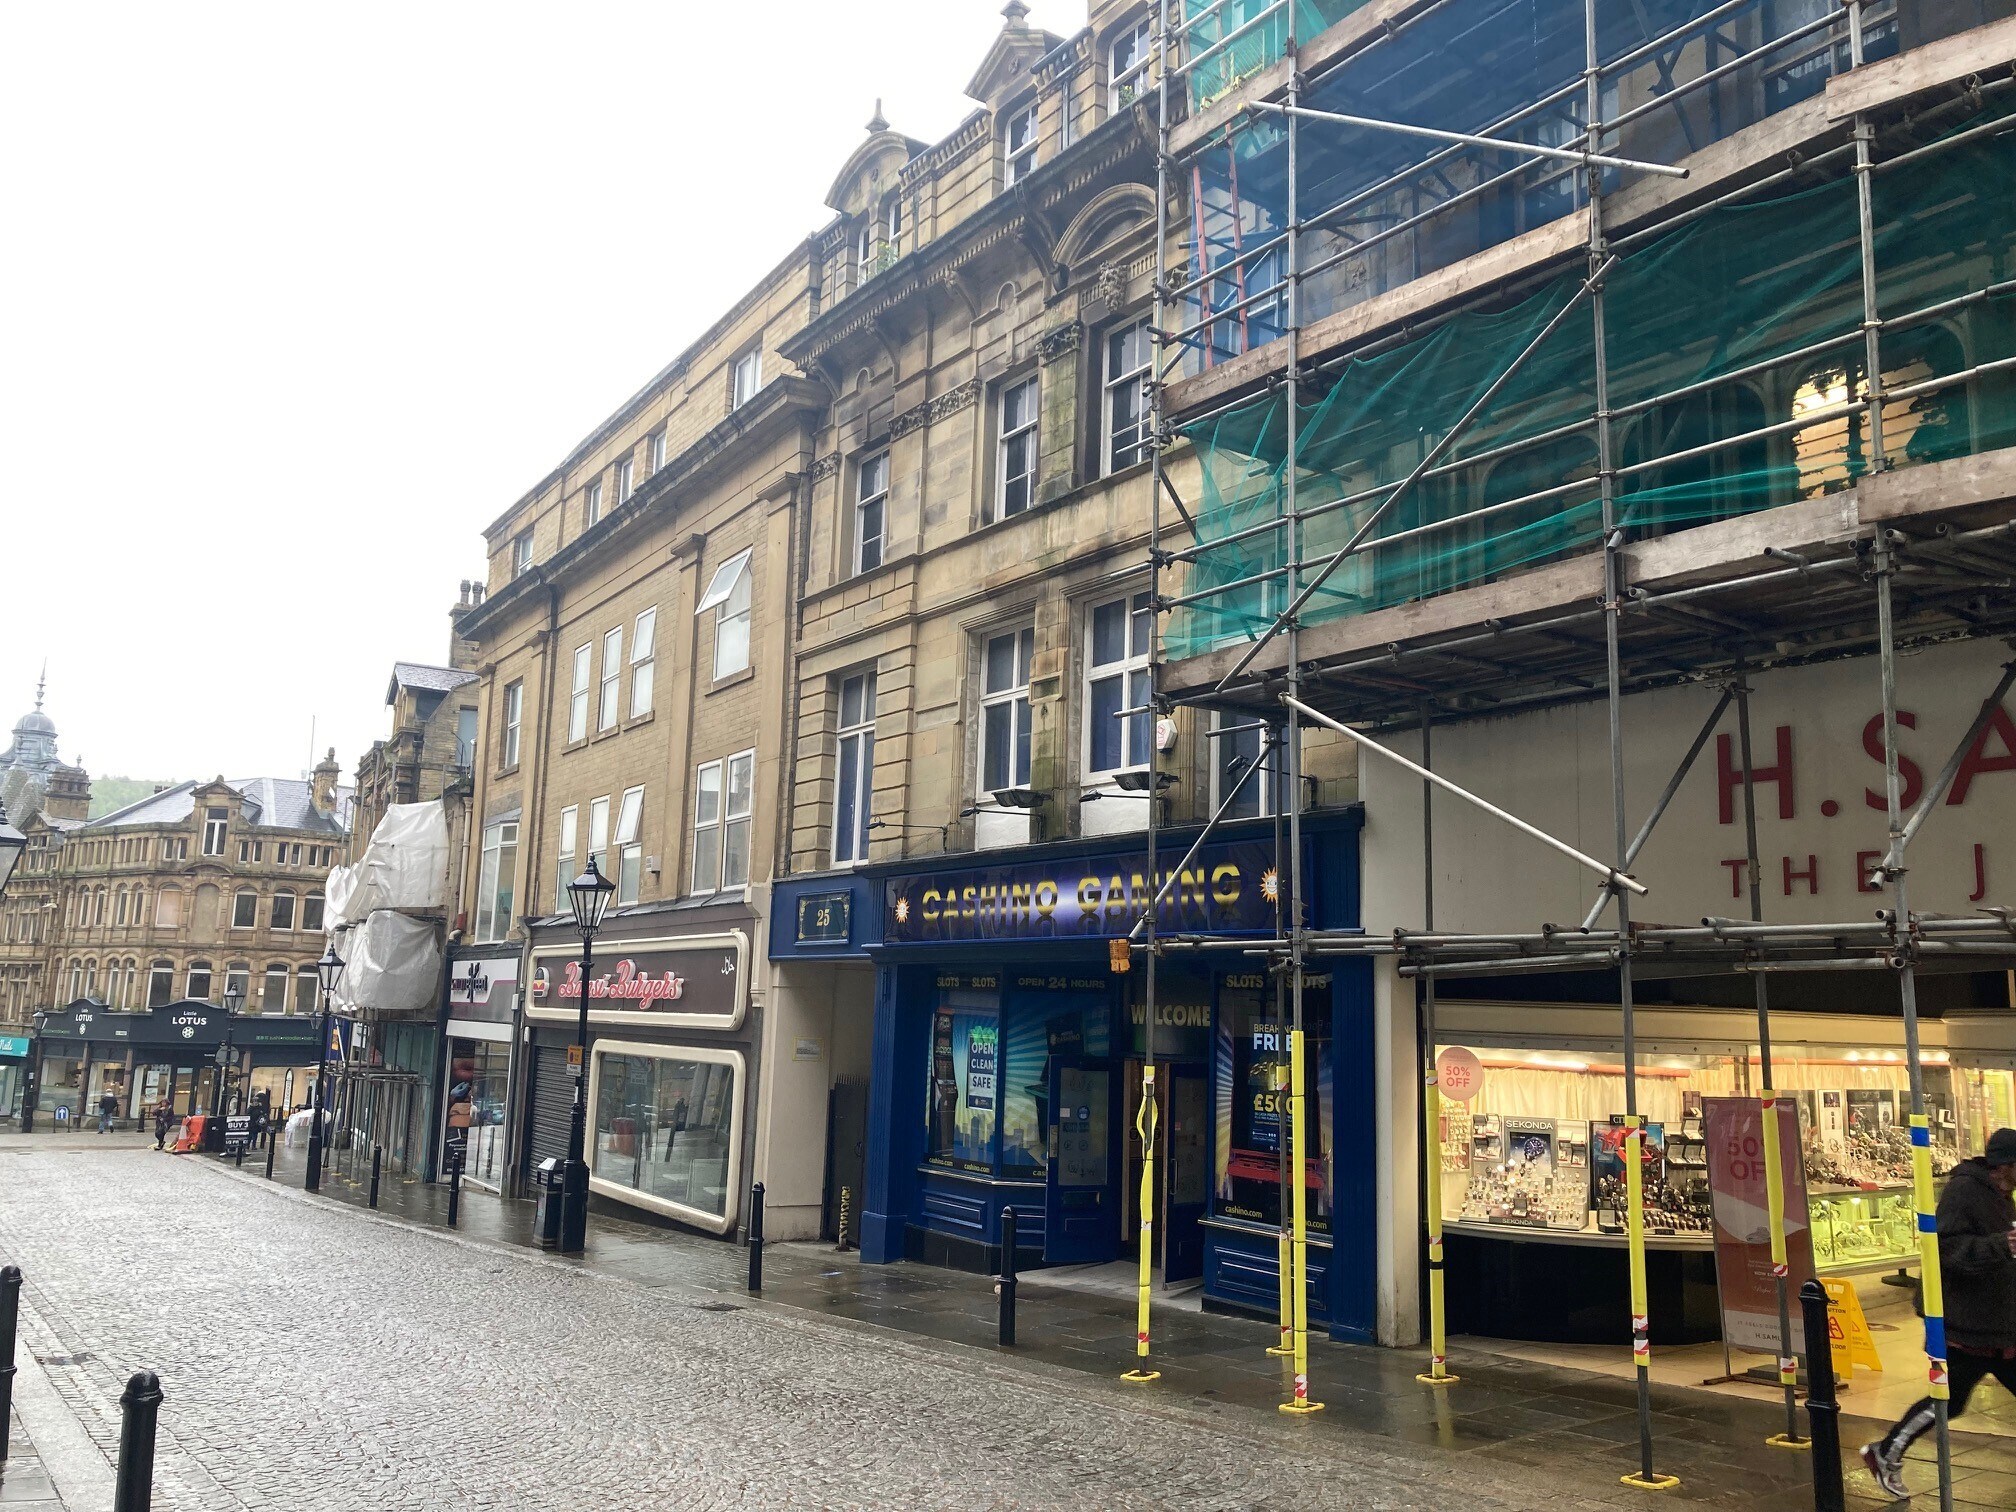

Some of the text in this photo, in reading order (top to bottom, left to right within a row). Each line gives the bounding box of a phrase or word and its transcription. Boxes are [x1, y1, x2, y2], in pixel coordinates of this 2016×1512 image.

[1720, 850, 1884, 898] THE
[922, 863, 1241, 922] CASHINO GAMING
[816, 908, 831, 927] 25
[609, 958, 684, 1010] Burgers
[937, 977, 960, 988] SLOTS
[971, 976, 996, 988] SLOTS
[1018, 976, 1106, 989] OPEN 24 HOURS
[1226, 974, 1264, 989] SLOTS
[1285, 974, 1327, 990] SOTS
[75, 1014, 93, 1022] LOTUS
[172, 1016, 207, 1026] LOTUS
[1130, 1003, 1211, 1027] WLCOME
[971, 1042, 994, 1055] OPEN
[971, 1058, 994, 1070] CLEAN
[1445, 1066, 1471, 1077] 50%
[972, 1075, 991, 1089] SAFE
[1446, 1077, 1471, 1088] OFF
[228, 1121, 243, 1129] BUY
[1505, 1119, 1554, 1130] SEKONDA
[1726, 1136, 1765, 1157] 50
[928, 1157, 954, 1168] cashino.com
[963, 1163, 991, 1174] cashino.com
[1730, 1160, 1766, 1181] OF
[1224, 1205, 1263, 1219] cashino.com
[1502, 1218, 1534, 1226] SEKONDA
